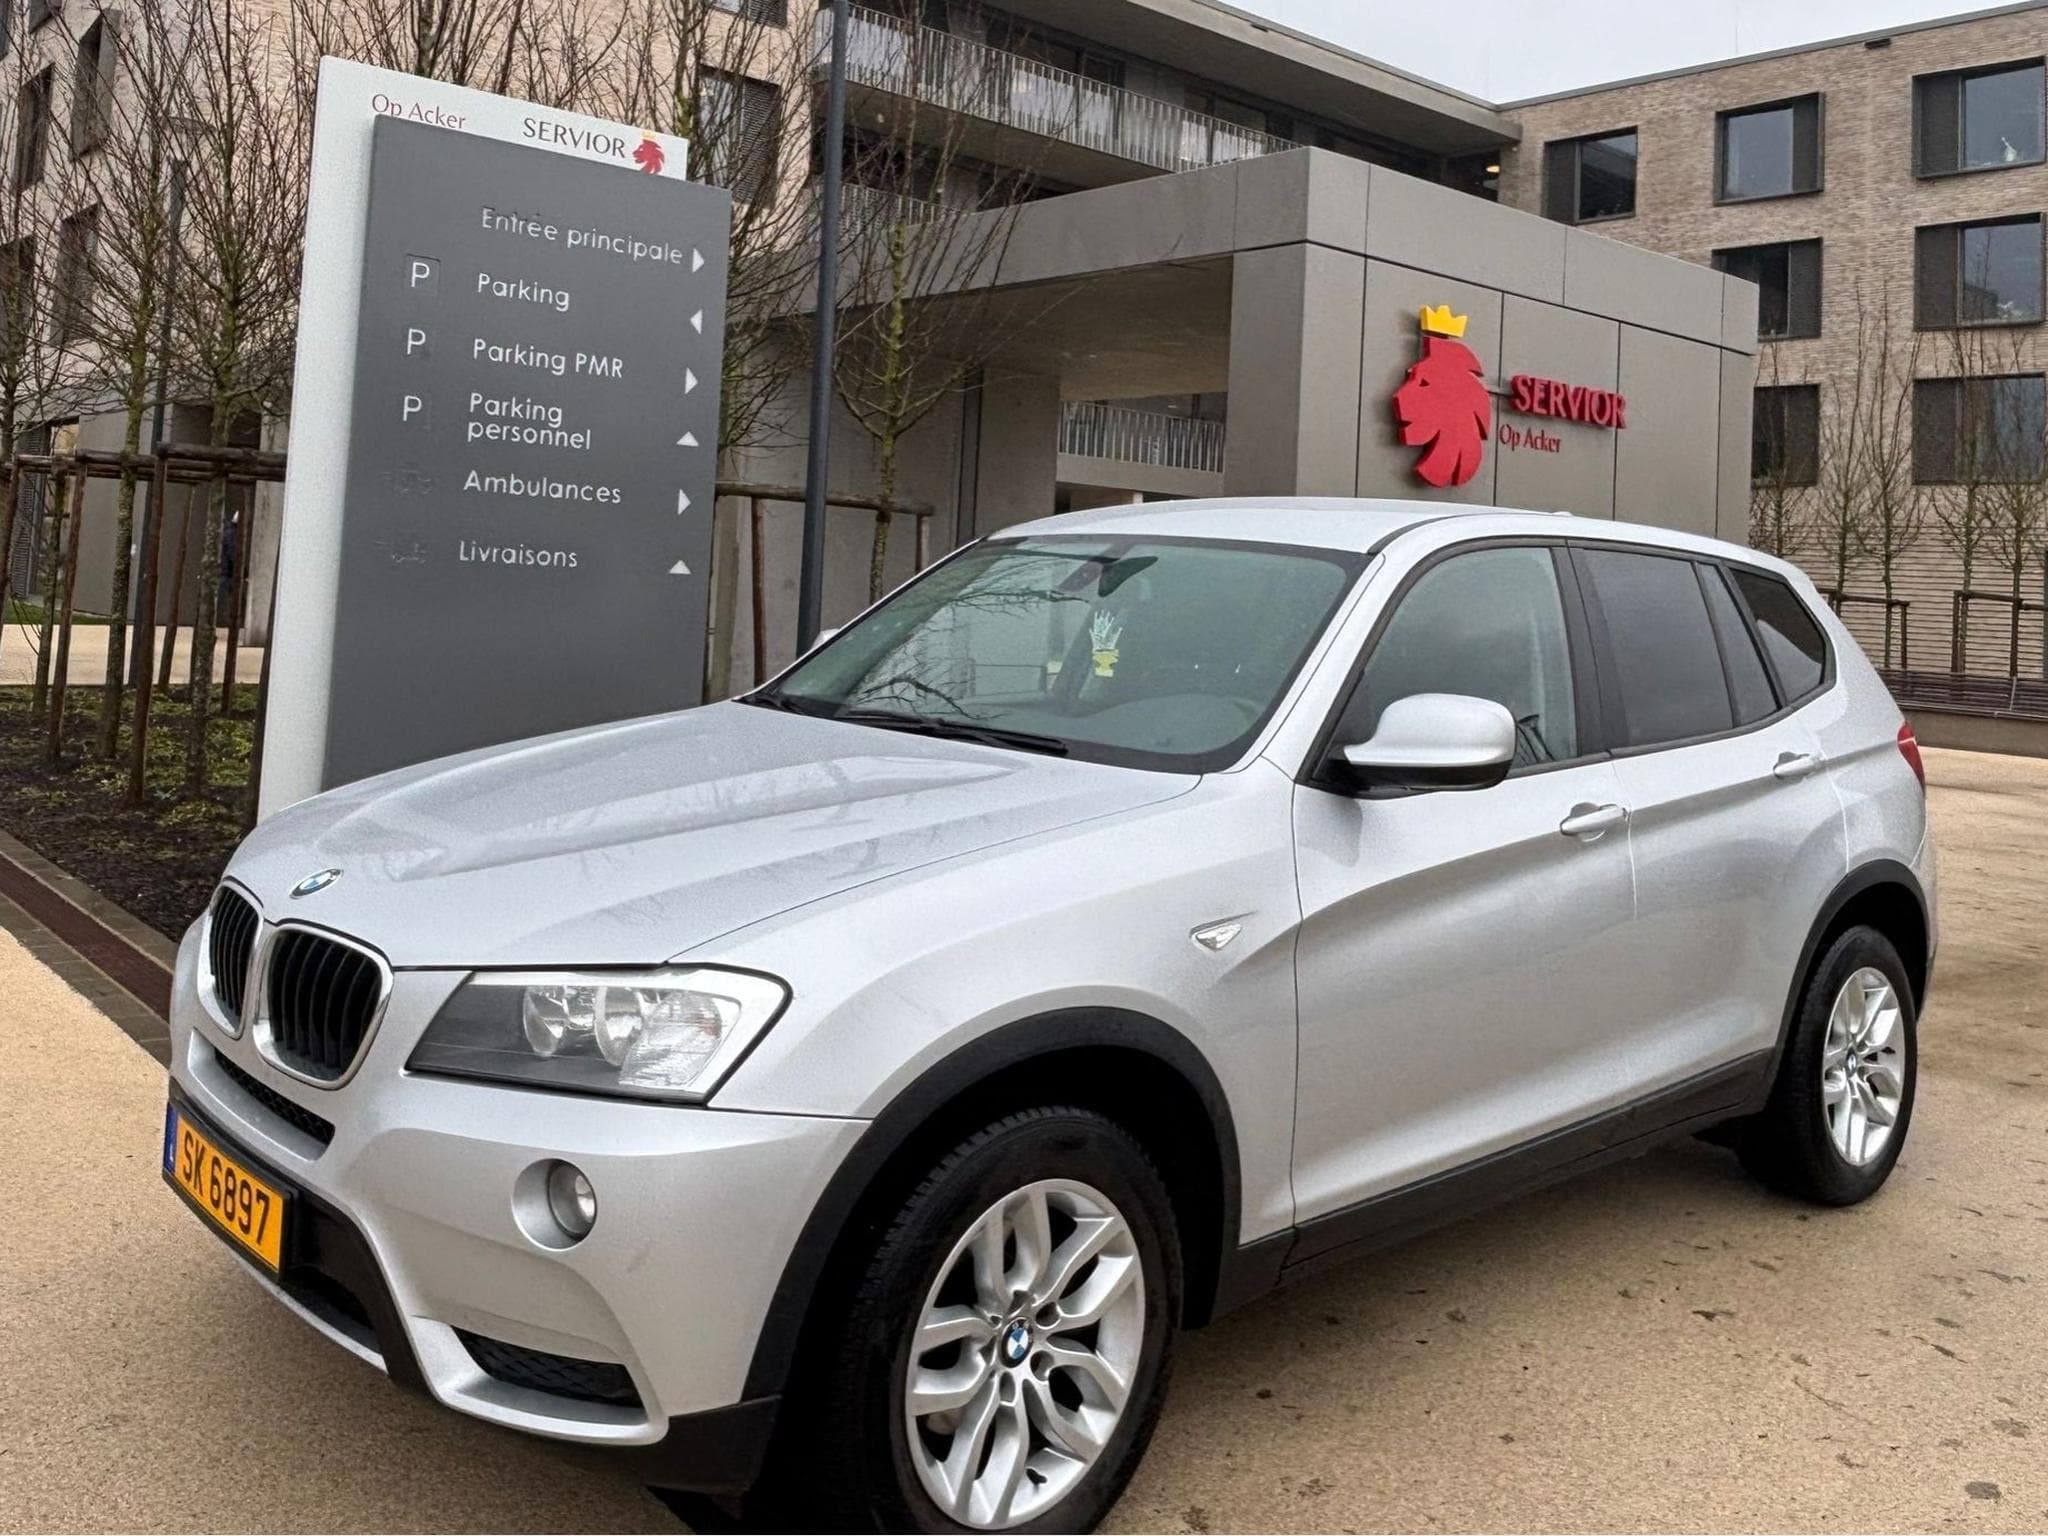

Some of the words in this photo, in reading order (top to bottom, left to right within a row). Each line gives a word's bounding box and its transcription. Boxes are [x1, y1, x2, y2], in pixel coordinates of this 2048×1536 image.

[372, 93, 402, 117] Op
[408, 102, 466, 129] Acker
[523, 117, 626, 159] SERVIOR
[567, 222, 683, 265] principale
[411, 261, 430, 288] P
[477, 272, 570, 312] Parking
[407, 328, 426, 355] P
[473, 338, 566, 376] Parking
[575, 353, 624, 379] PMR
[402, 395, 422, 422] P
[469, 392, 563, 428] Parking
[1509, 374, 1627, 429] SERVIOR
[467, 421, 592, 450] personnel
[1500, 424, 1521, 451] Op
[1523, 427, 1562, 453] Acker
[463, 470, 622, 504] Ambulances
[459, 540, 578, 568] Livraisons
[183, 1130, 205, 1197] SK
[210, 1156, 270, 1246] 6897
